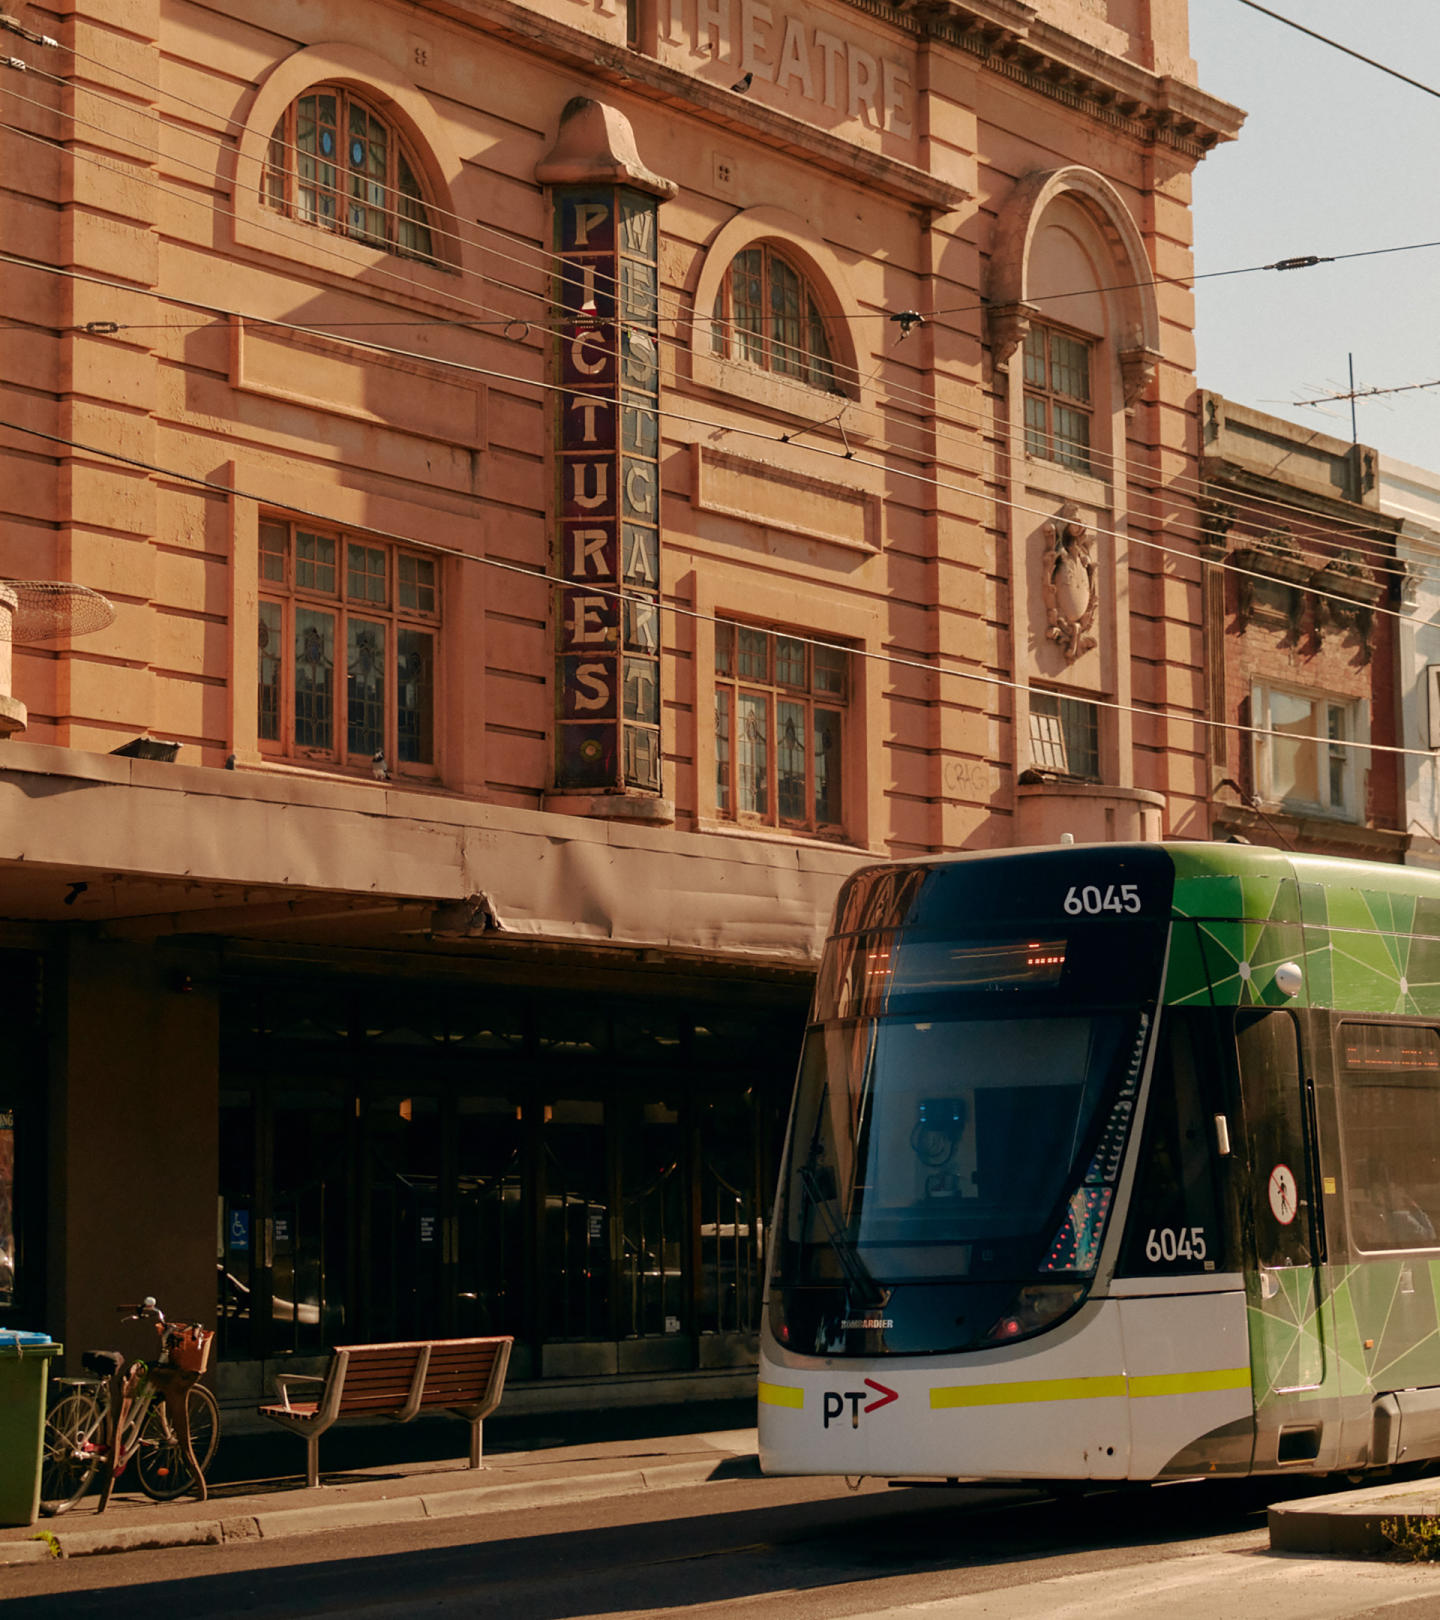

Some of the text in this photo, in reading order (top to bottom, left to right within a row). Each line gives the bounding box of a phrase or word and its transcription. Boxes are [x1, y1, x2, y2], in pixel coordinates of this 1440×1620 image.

[570, 203, 611, 711] PICTURES
[623, 206, 658, 790] WESTGARTH
[1063, 884, 1142, 915] 6045
[1145, 1227, 1207, 1262] 6045
